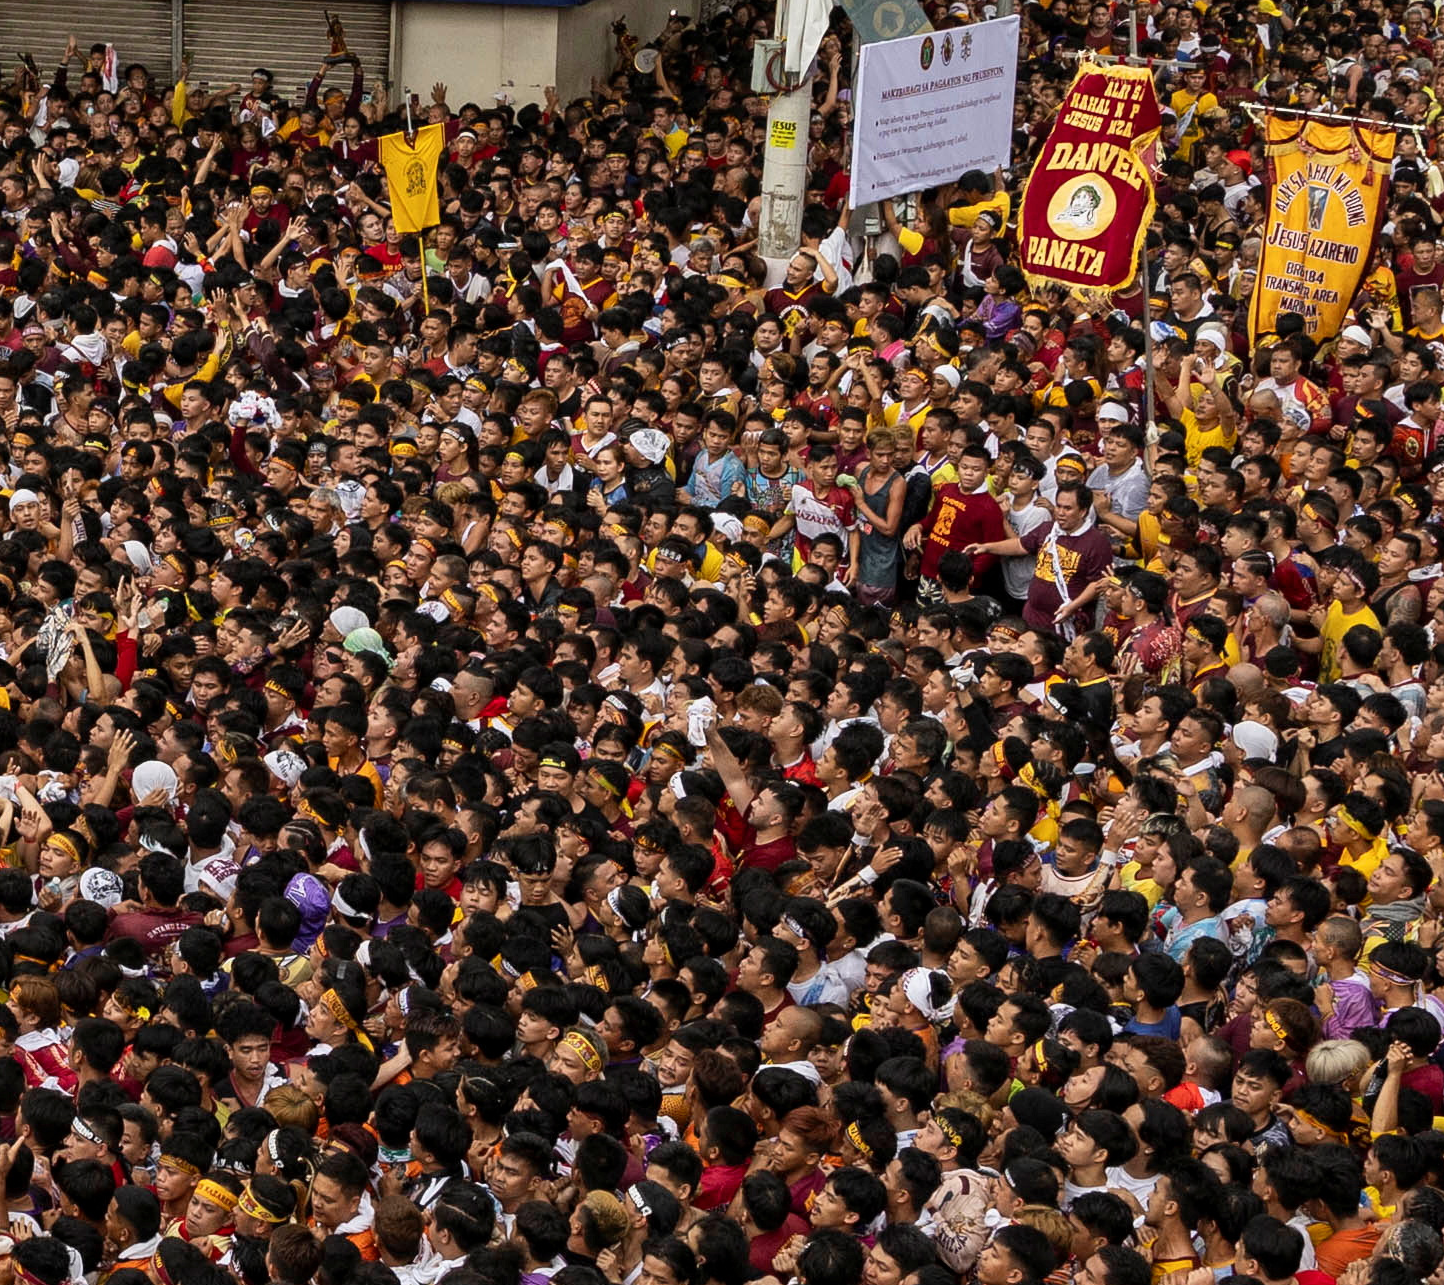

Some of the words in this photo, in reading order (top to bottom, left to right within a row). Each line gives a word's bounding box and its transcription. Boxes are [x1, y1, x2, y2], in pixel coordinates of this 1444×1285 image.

[1063, 111, 1103, 132] JESUS
[1275, 184, 1294, 215] ALAY
[1291, 171, 1308, 192] SA
[1332, 173, 1352, 194] NA
[1343, 189, 1367, 229] POONG
[1027, 236, 1107, 277] PANATA
[1312, 289, 1339, 304] AREA
